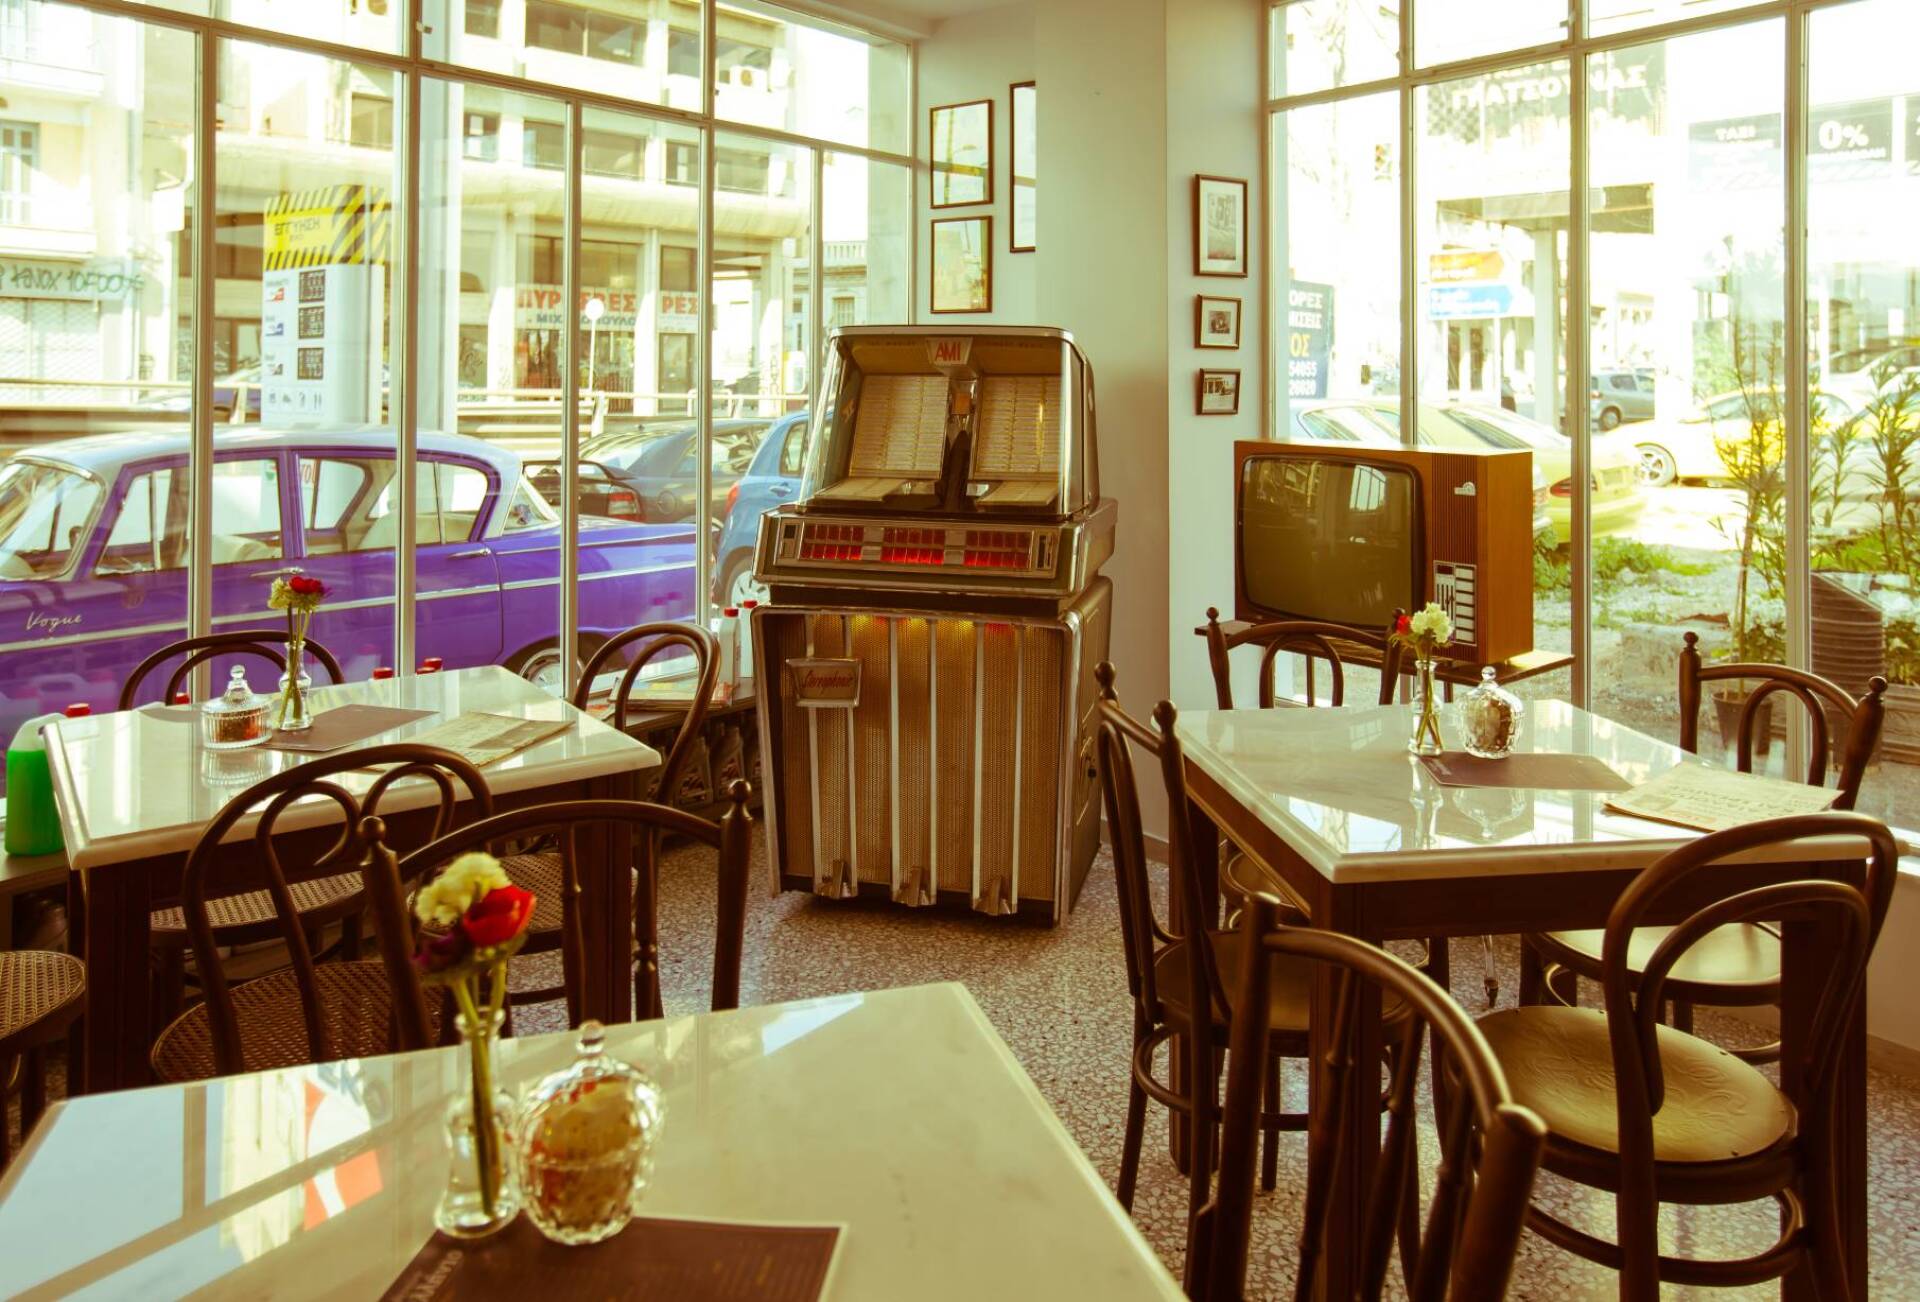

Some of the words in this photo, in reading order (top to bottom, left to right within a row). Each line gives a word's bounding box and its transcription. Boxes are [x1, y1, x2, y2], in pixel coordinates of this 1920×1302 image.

[1818, 119, 1870, 150] 0%
[934, 342, 962, 362] AMI
[25, 611, 83, 632] Vogue
